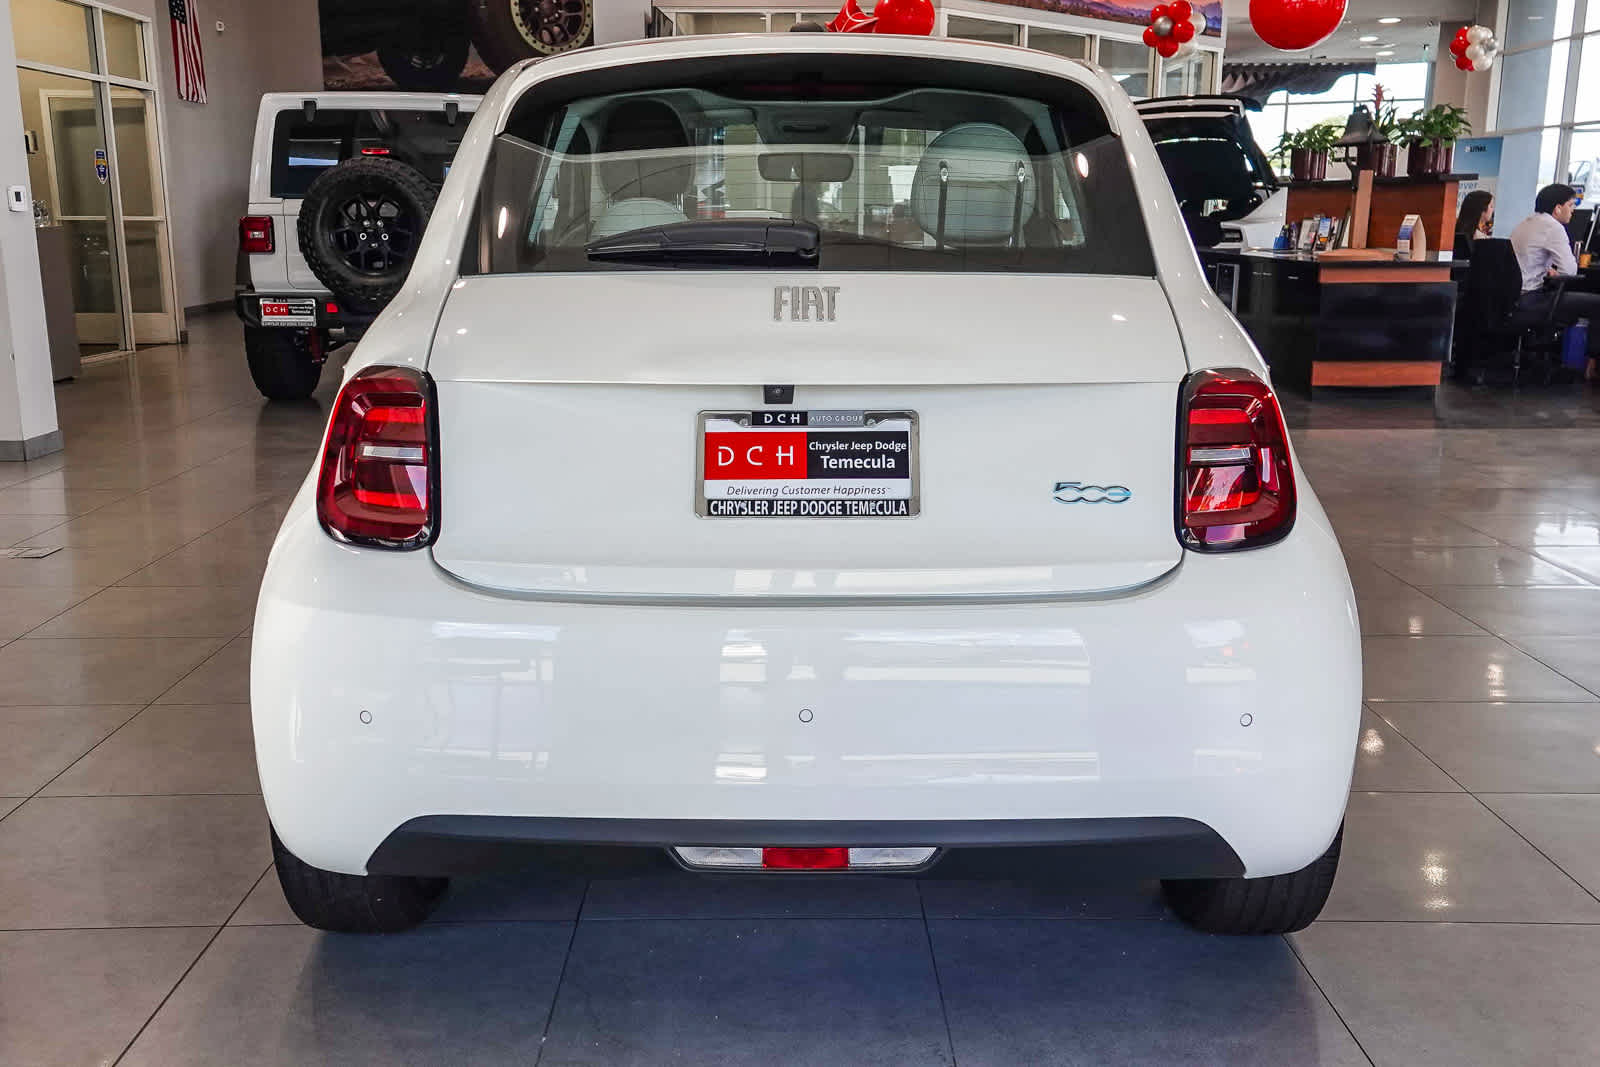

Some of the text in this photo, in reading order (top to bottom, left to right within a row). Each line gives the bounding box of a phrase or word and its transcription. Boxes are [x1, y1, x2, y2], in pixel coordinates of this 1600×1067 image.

[774, 286, 840, 321] FIAT
[763, 413, 800, 424] DCH
[808, 441, 907, 453] Chrysler Jeep Dodge
[717, 445, 794, 466] DCH
[820, 454, 896, 469] Temecula
[727, 486, 779, 497] Delivering
[781, 485, 831, 495] Customer
[710, 500, 908, 515] CHRYSLER JEEP DODGE TEMECULA
